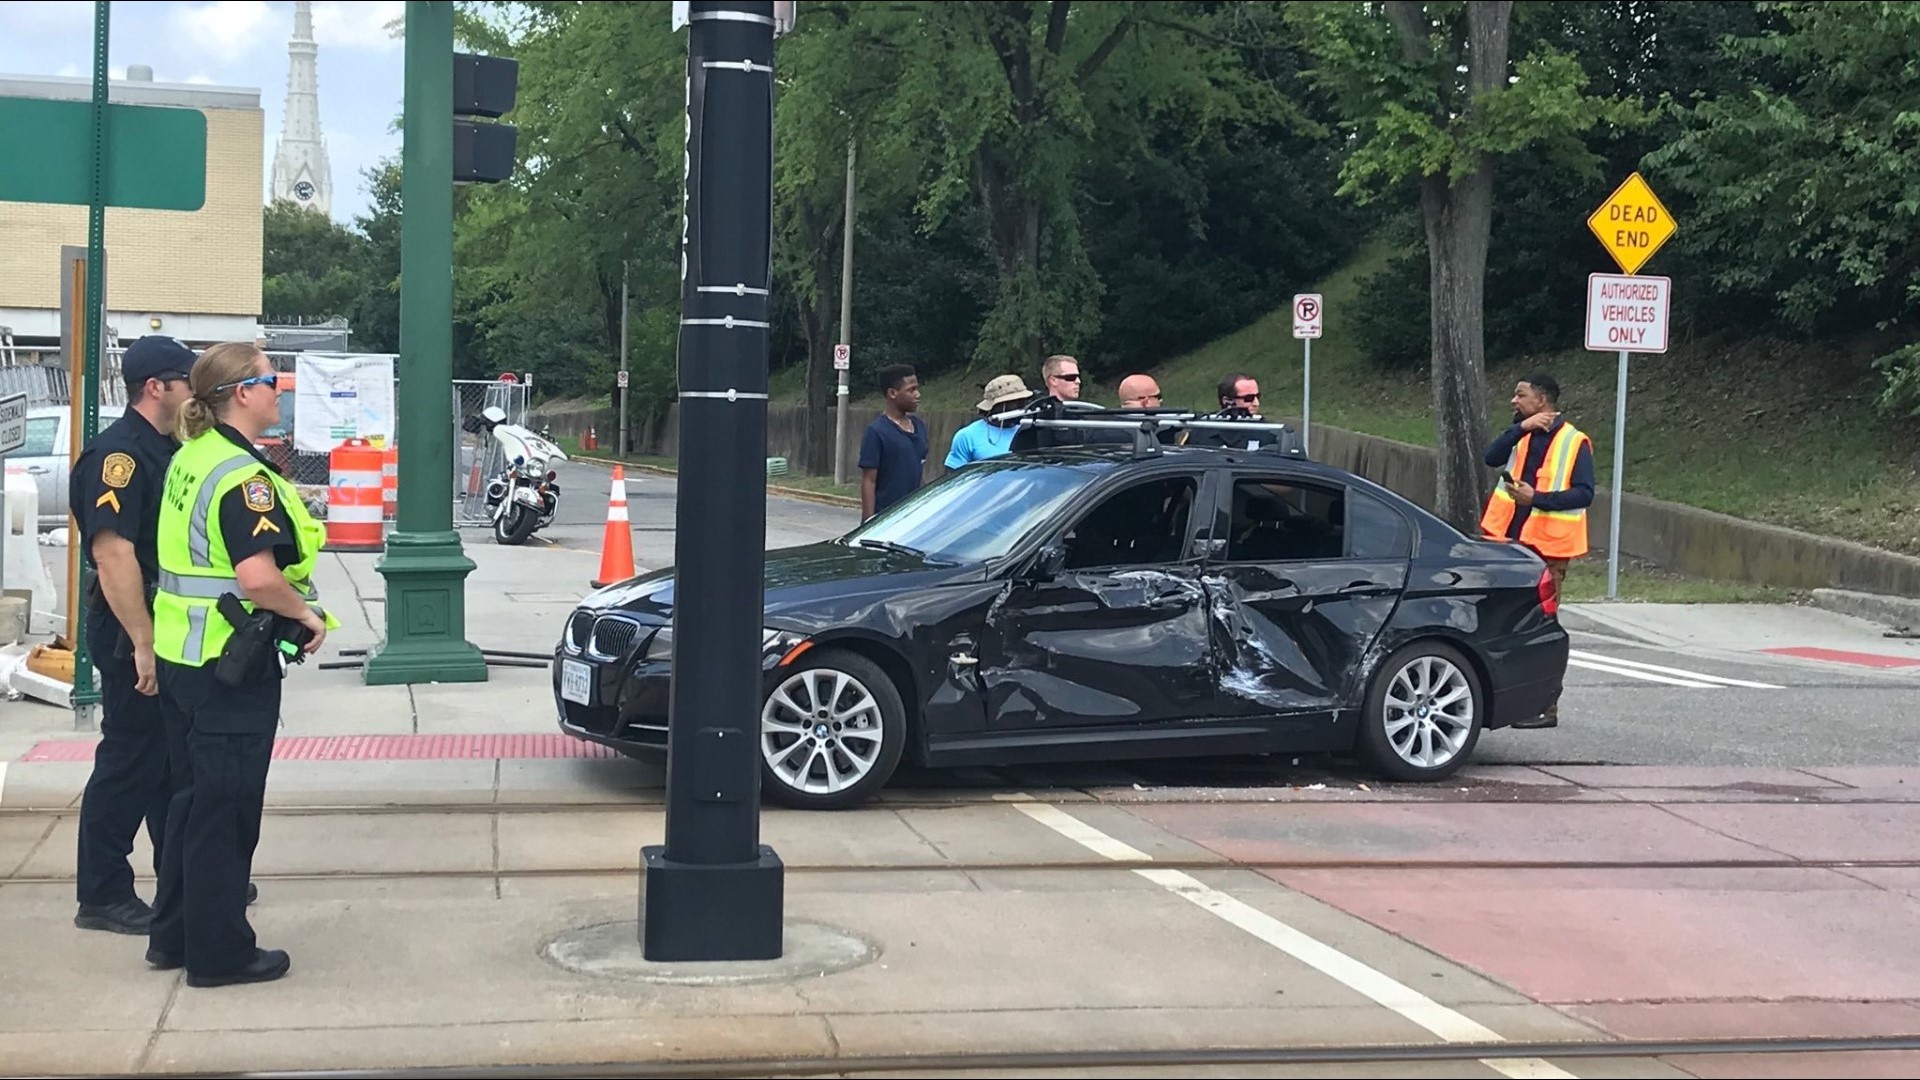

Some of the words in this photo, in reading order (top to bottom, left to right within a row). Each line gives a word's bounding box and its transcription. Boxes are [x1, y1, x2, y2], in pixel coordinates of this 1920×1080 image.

[1610, 204, 1657, 223] DEAD
[1616, 230, 1649, 248] END
[1601, 283, 1658, 301] AUTHORIZED
[1602, 304, 1655, 323] VEHICLES
[1608, 326, 1646, 344] ONLY
[2, 425, 21, 445] CLOSED
